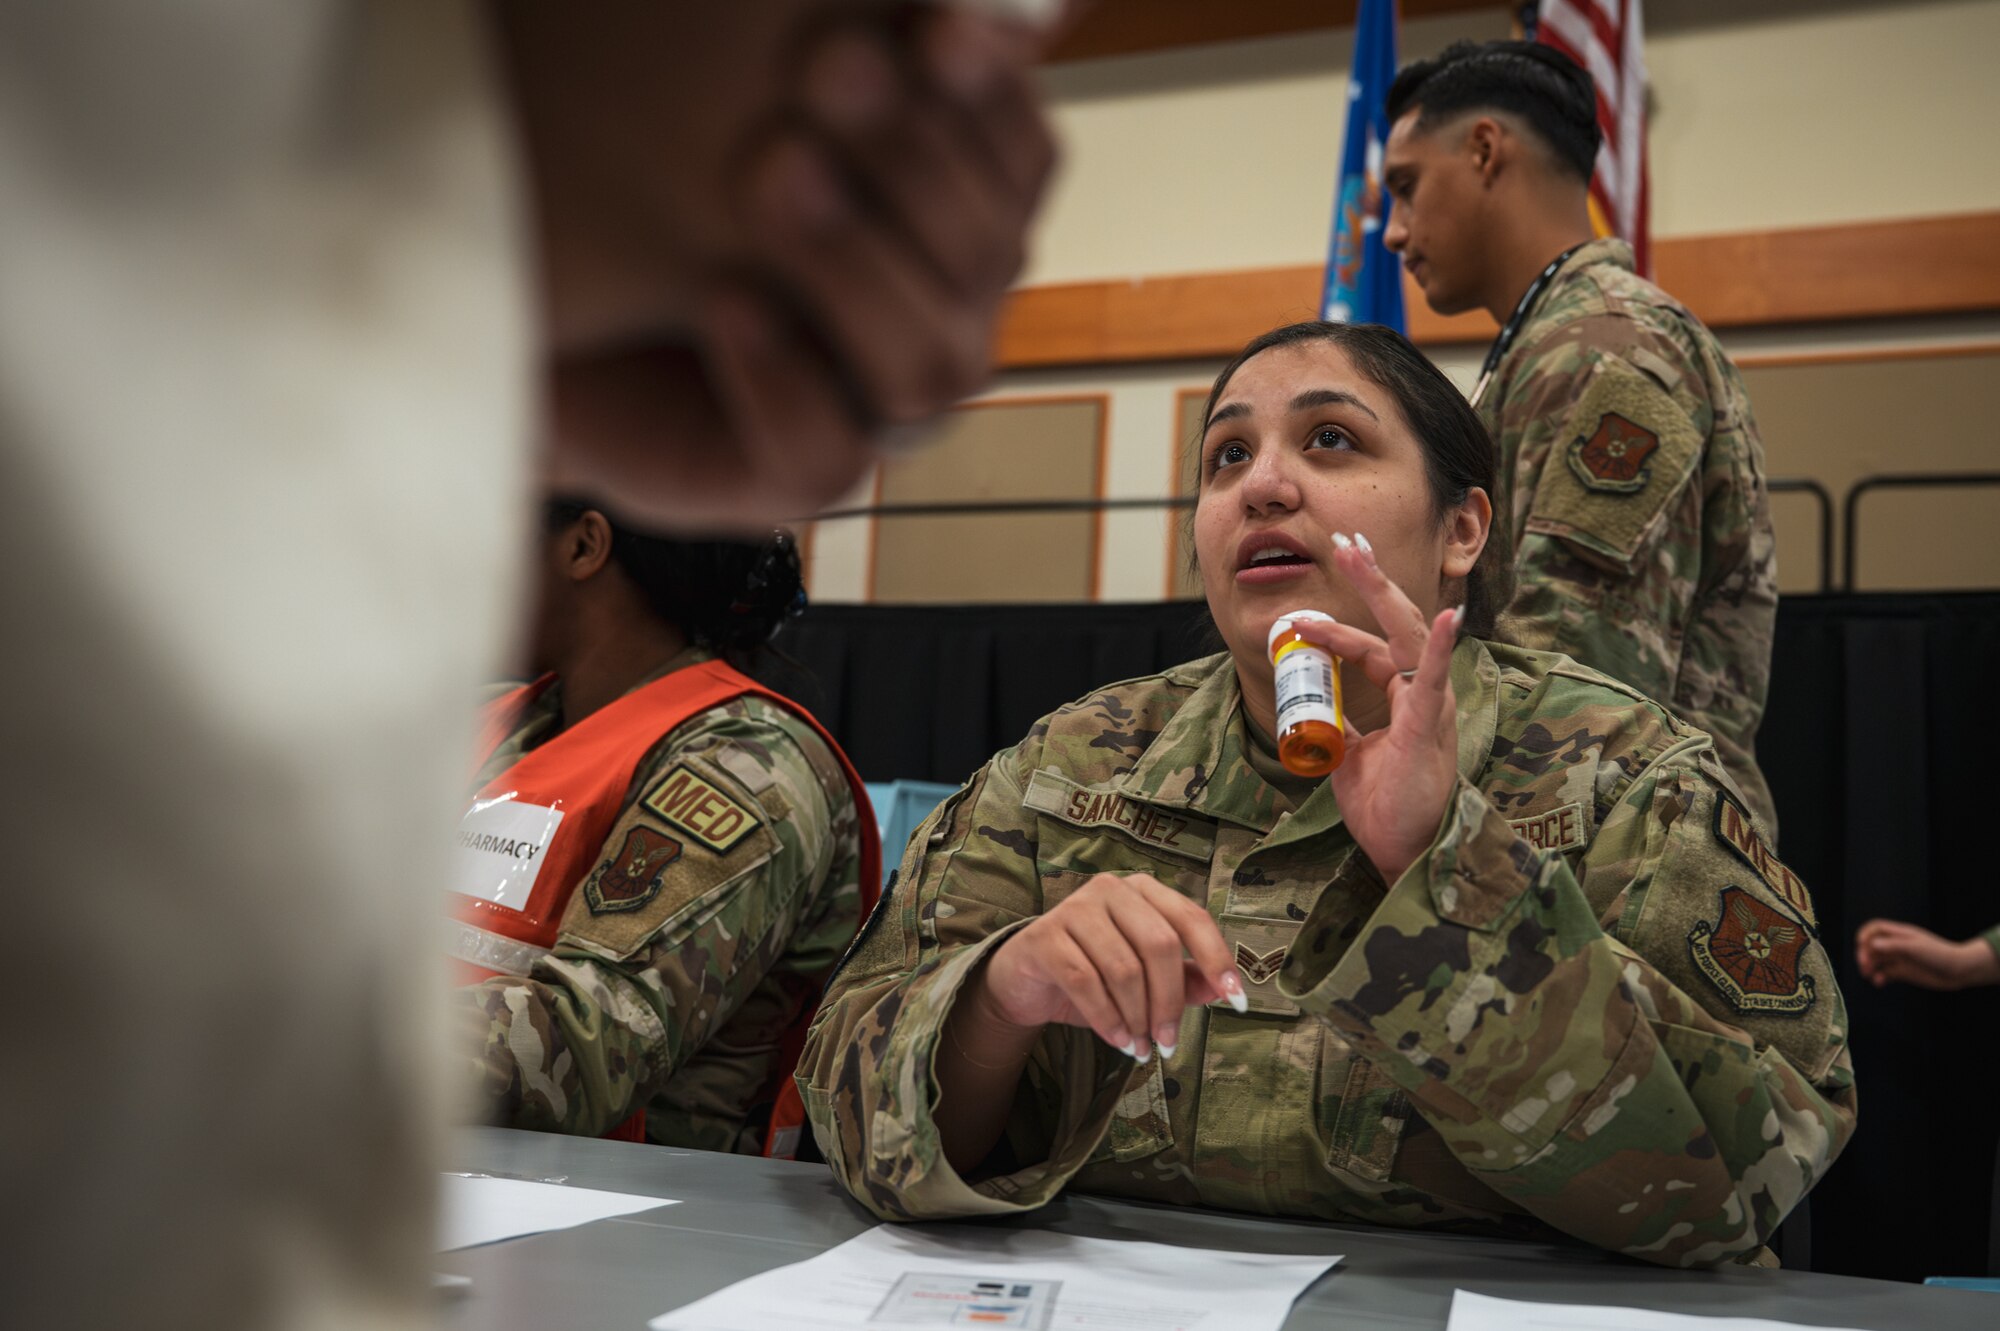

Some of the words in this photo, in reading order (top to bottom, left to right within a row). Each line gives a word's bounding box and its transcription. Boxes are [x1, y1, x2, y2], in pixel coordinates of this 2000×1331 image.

[653, 773, 744, 842] MED
[1067, 790, 1187, 846] SANCHEZ
[1727, 805, 1807, 911] MED
